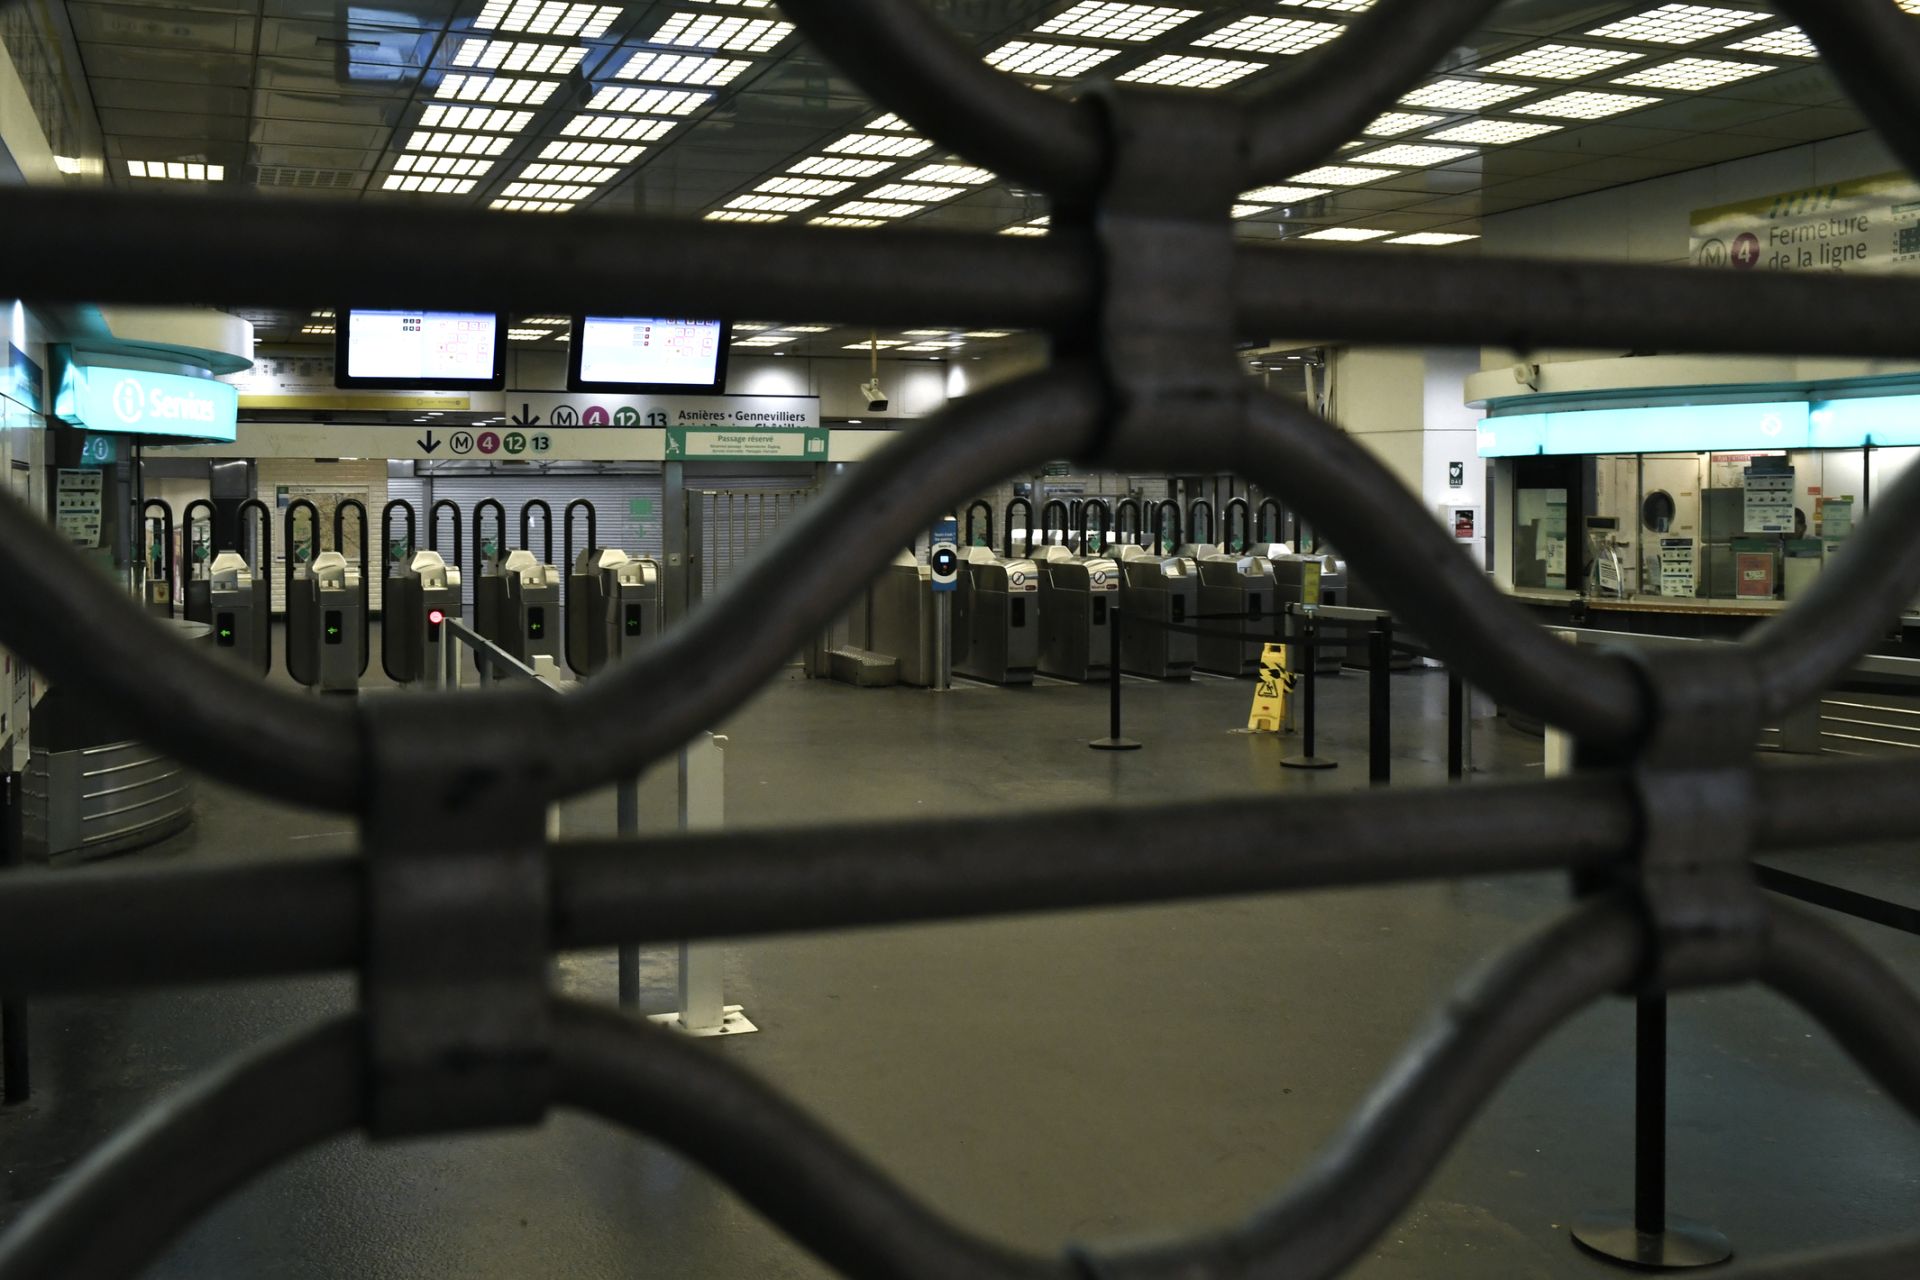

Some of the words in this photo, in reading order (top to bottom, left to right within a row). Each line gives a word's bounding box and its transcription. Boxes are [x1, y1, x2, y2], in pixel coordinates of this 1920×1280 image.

[1769, 215, 1869, 247] Fermeture
[1737, 240, 1752, 263] 4
[1768, 251, 1791, 271] de
[1797, 247, 1813, 268] la
[1820, 242, 1867, 271] ligne
[588, 411, 601, 426] 4
[616, 411, 637, 426] 12
[647, 412, 667, 426] 13
[678, 409, 725, 421] Asnières
[735, 410, 806, 422] Gennevilliers
[482, 436, 493, 450] 4
[506, 437, 523, 450] 12
[532, 436, 549, 450] 13
[717, 435, 745, 443] Passage
